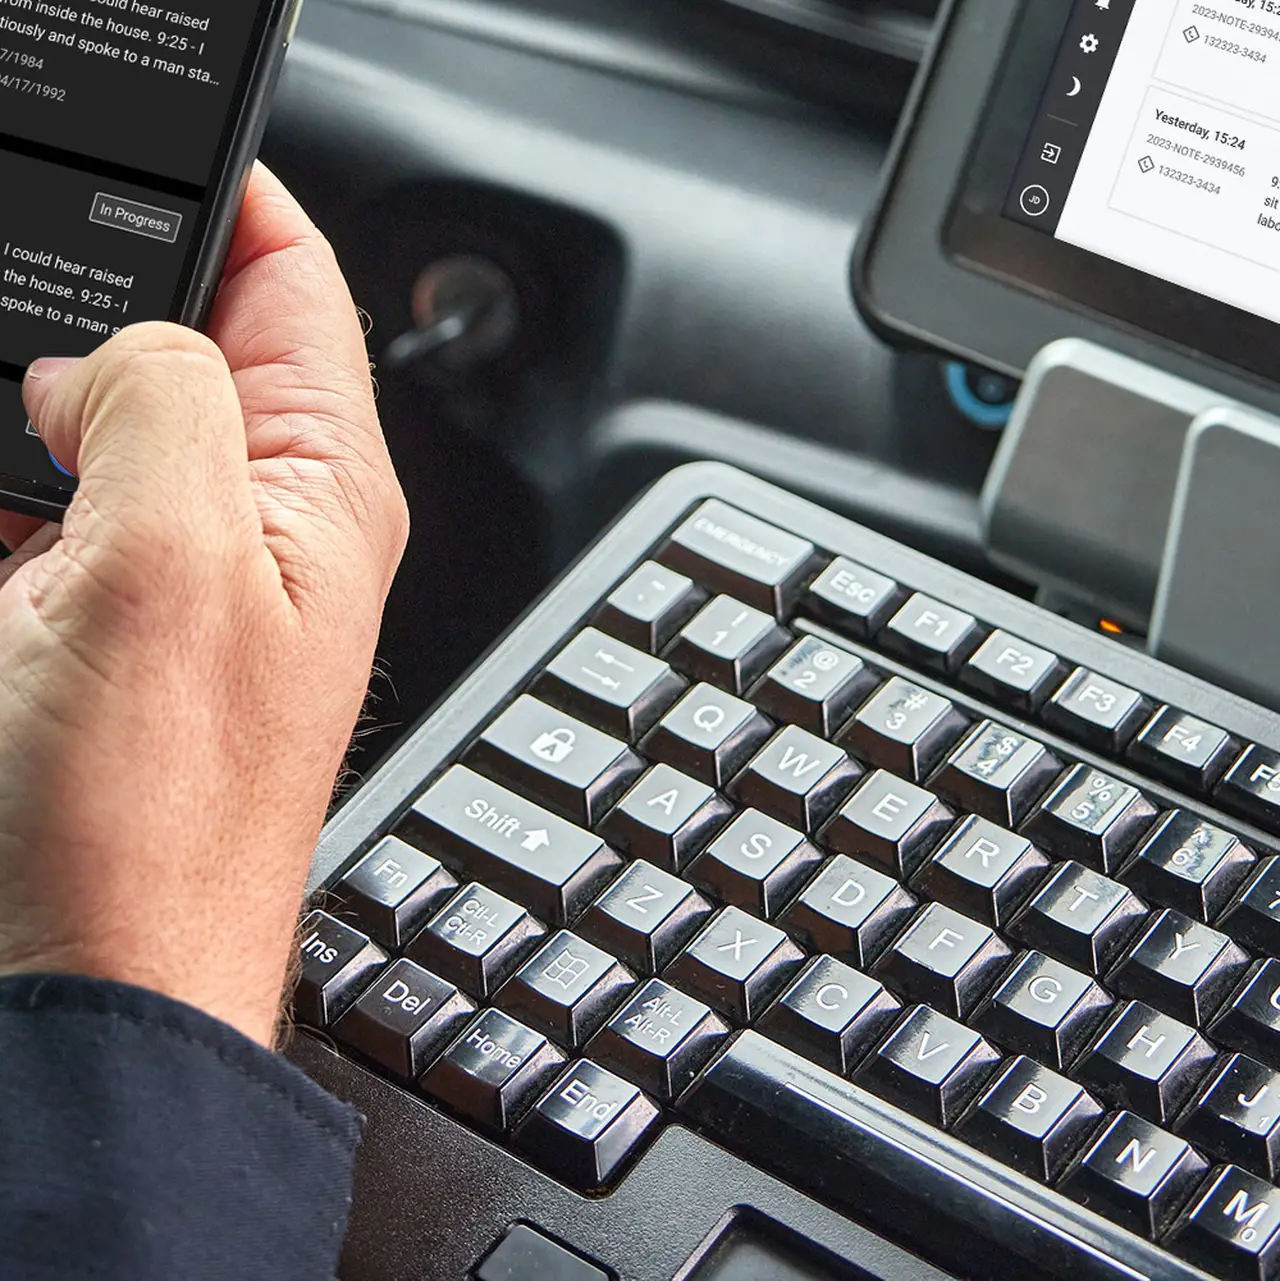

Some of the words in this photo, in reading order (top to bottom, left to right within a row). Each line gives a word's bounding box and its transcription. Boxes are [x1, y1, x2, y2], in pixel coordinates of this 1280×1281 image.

[35, 0, 78, 22] inside
[80, 12, 104, 29] the
[105, 17, 152, 42] house.
[157, 31, 189, 51] 9:25
[198, 42, 205, 55] I
[165, 11, 210, 31] raised
[47, 31, 76, 47] and
[77, 38, 121, 59] spoke
[123, 49, 138, 63] to
[140, 55, 151, 67] a
[152, 58, 185, 76] man
[99, 202, 113, 217] In
[114, 206, 171, 233] Progress
[694, 517, 789, 566] EMERGENCY
[830, 570, 876, 602] Esc
[914, 610, 947, 636] F1
[995, 647, 1034, 674] F2
[1077, 685, 1117, 712] F3
[693, 705, 725, 732] Q
[1163, 725, 1202, 753] F4
[777, 746, 820, 777] W
[465, 798, 521, 838] Shift
[872, 792, 907, 822] E
[373, 859, 408, 889] Fn
[461, 898, 498, 927] Ctl-L
[445, 917, 488, 946] Ctl-R
[300, 931, 339, 964] Ins
[383, 978, 431, 1016] Del
[642, 996, 681, 1026] Alt-L
[624, 1012, 672, 1044] Alt-R
[466, 1028, 522, 1070] Home
[560, 1079, 618, 1119] End
